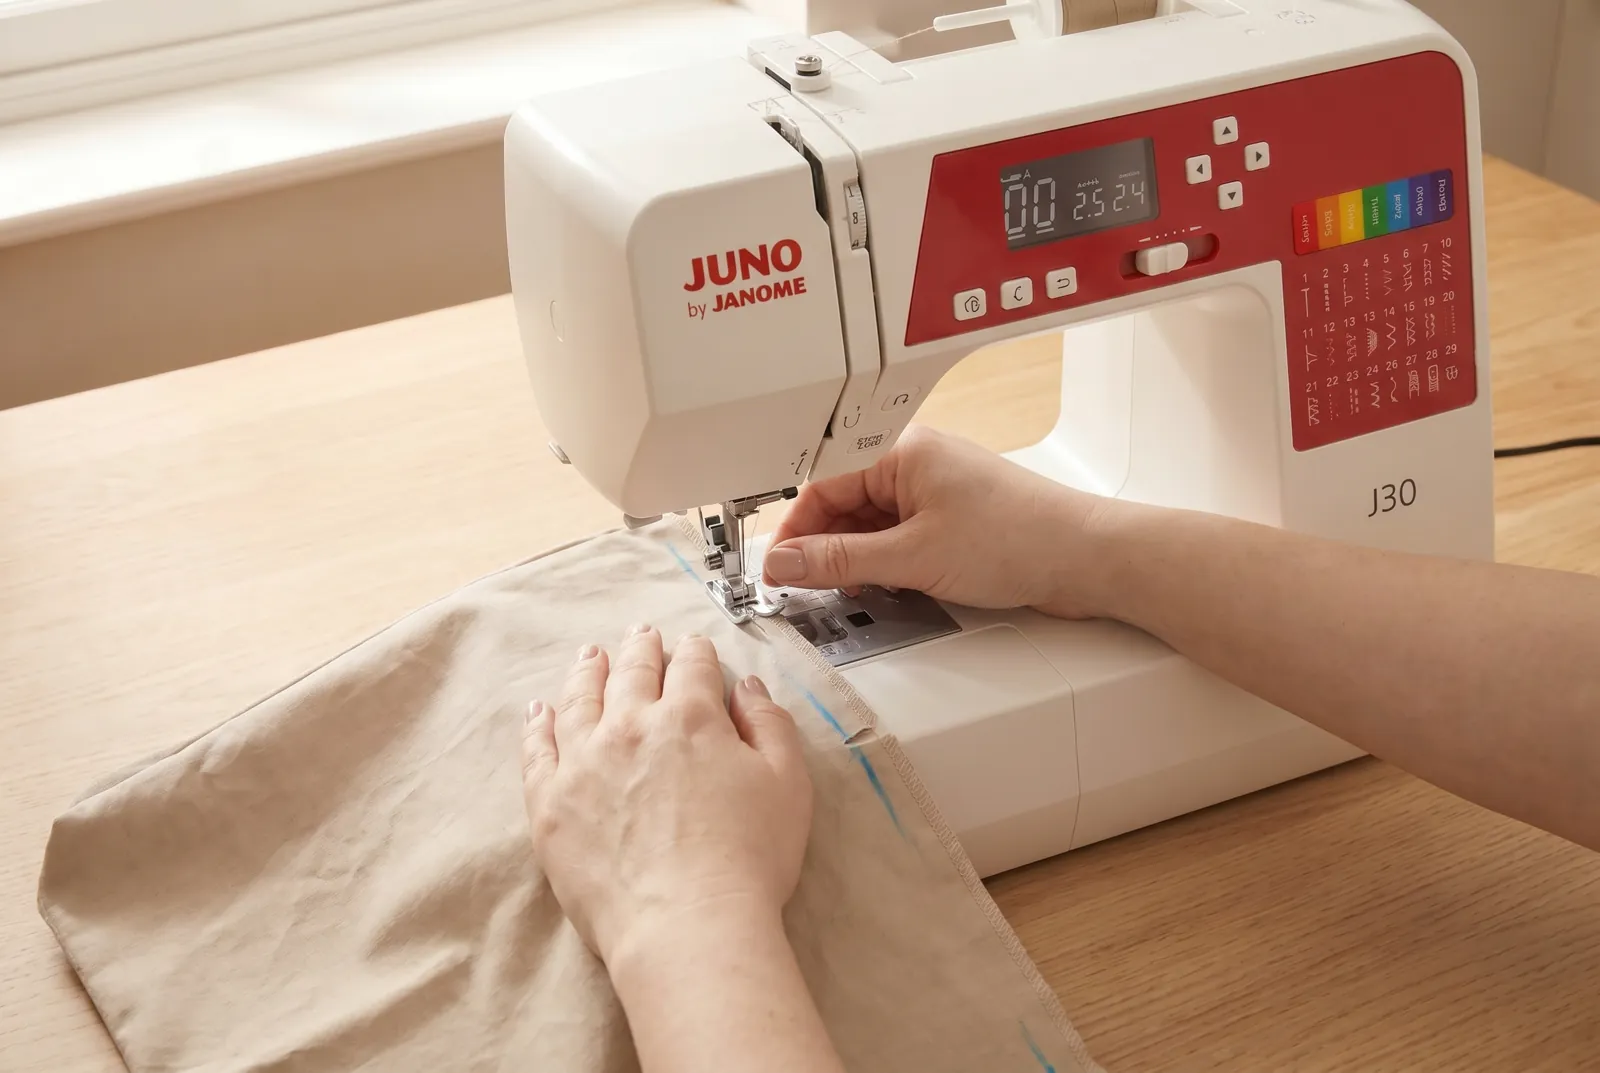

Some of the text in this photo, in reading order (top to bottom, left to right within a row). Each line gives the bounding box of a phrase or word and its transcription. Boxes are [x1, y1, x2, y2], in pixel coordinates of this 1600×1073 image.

[852, 212, 859, 224] 8
[1004, 177, 1056, 235] 00
[683, 239, 802, 292] JUNO
[1302, 238, 1452, 283] 1 2 3 4 5 6 7 10
[688, 277, 807, 320] by JANOME
[1302, 328, 1314, 339] 11
[1324, 322, 1336, 332] 12
[1344, 316, 1356, 328] 13
[1364, 311, 1376, 322] 13
[1384, 306, 1396, 318] 14
[1424, 296, 1435, 306] 19
[1442, 290, 1455, 302] 20
[1306, 344, 1457, 393] 21 22 23 24 26 27 28 29
[1368, 478, 1416, 518] J30
